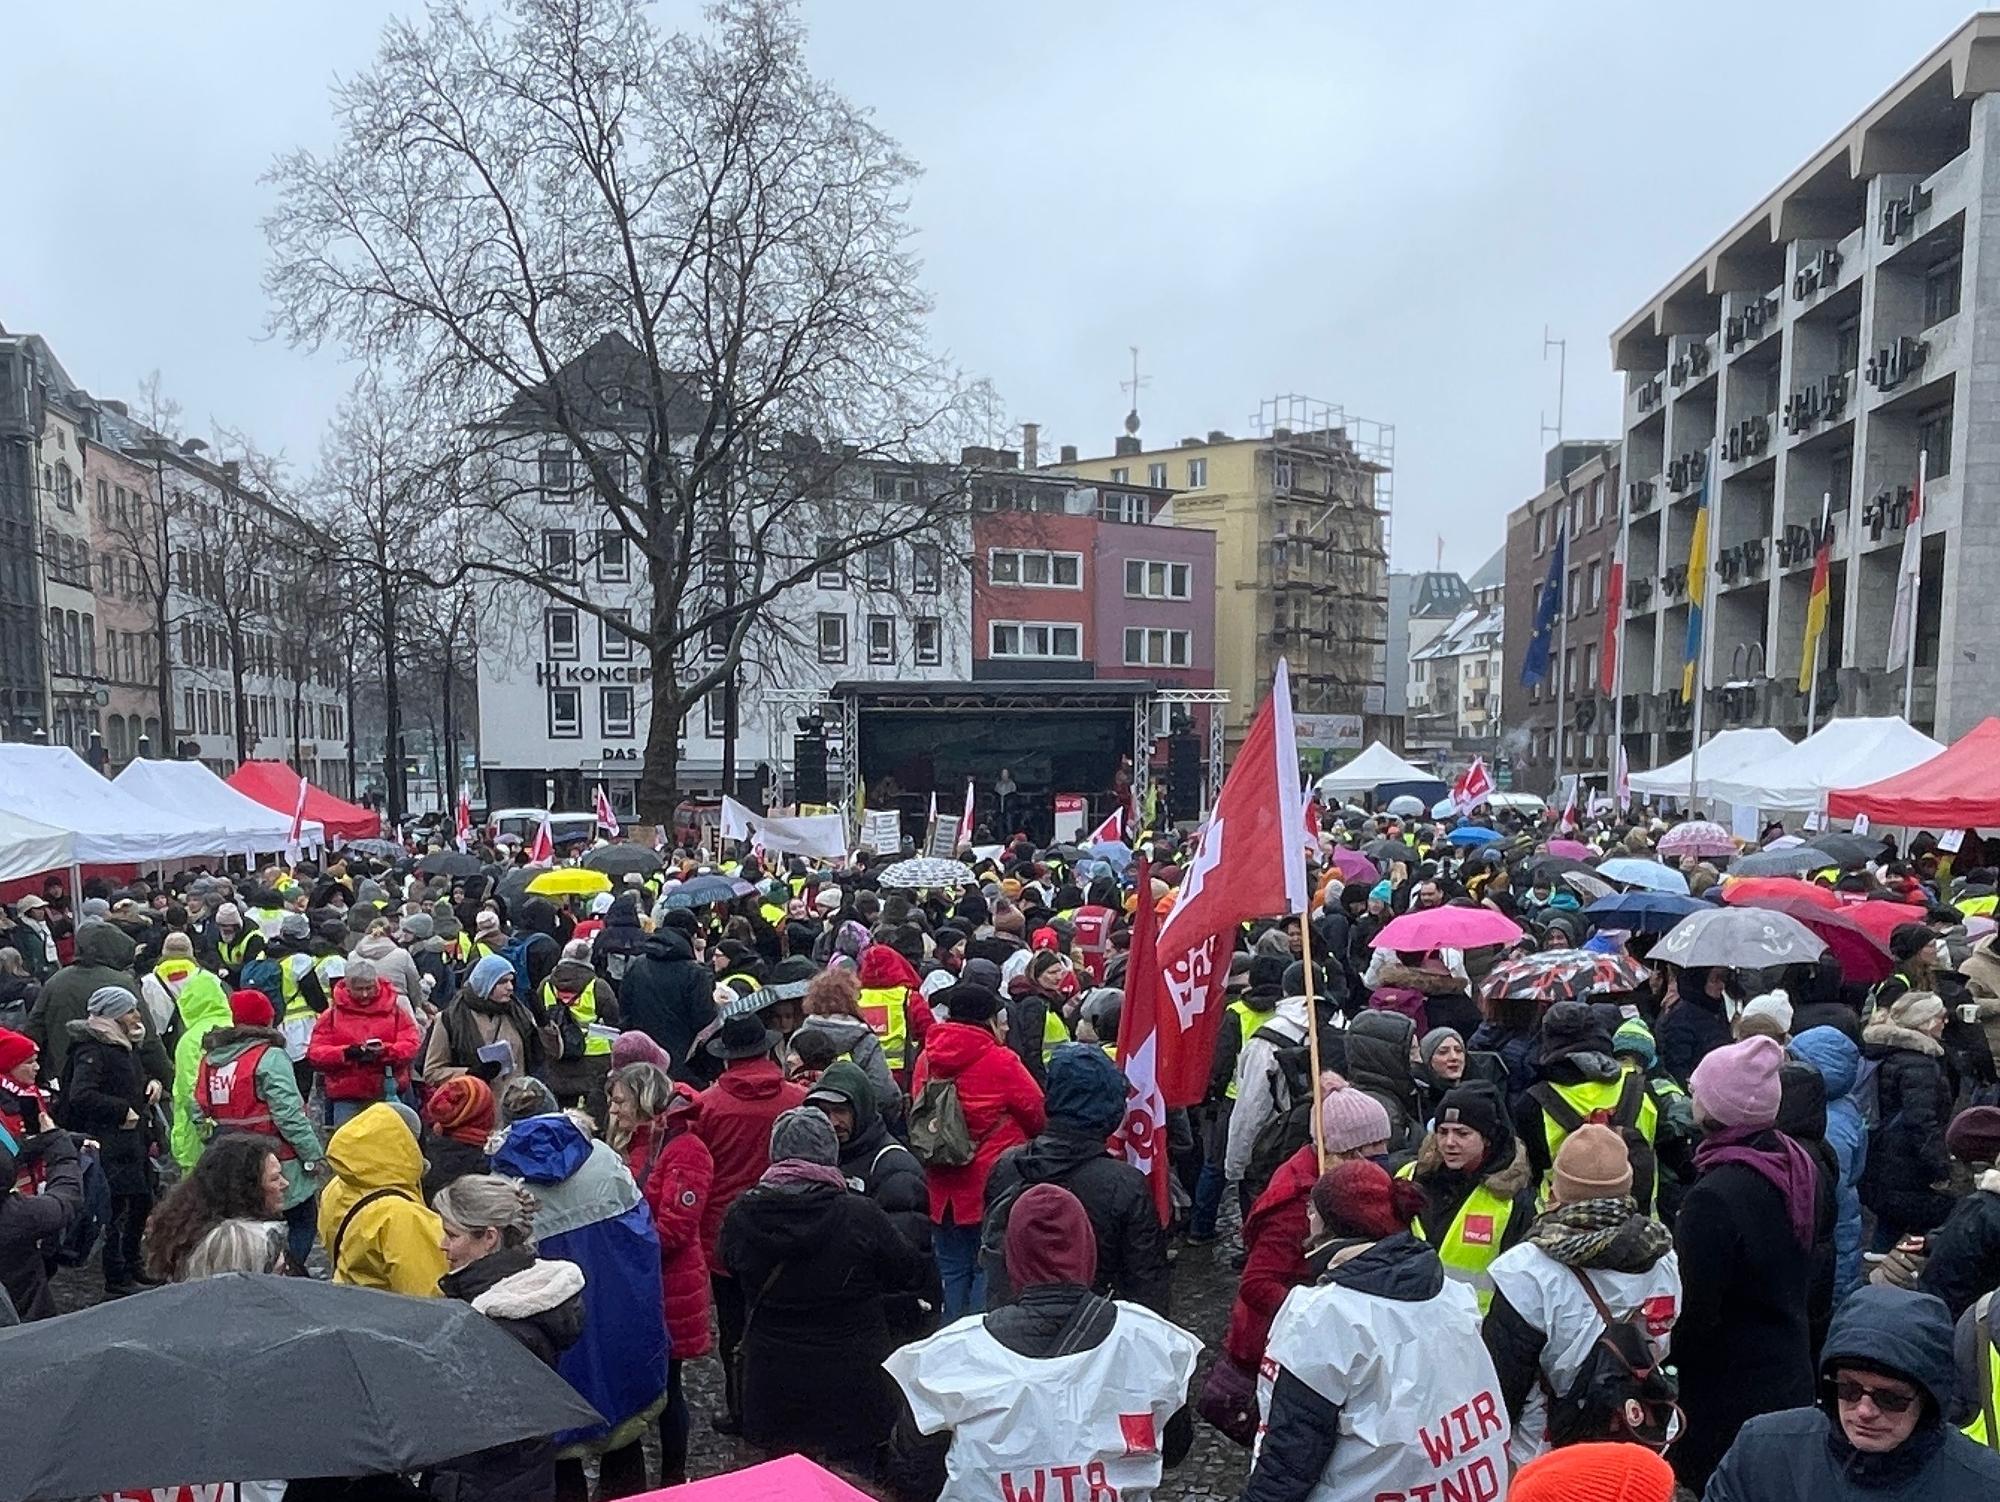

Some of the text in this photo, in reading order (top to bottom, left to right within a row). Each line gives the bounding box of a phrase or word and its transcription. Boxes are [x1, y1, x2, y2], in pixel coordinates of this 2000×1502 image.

[566, 666, 652, 683] KONCEP
[602, 748, 638, 760] DAS
[1418, 1391, 1503, 1468] WIR
[1374, 1456, 1499, 1502] ND
